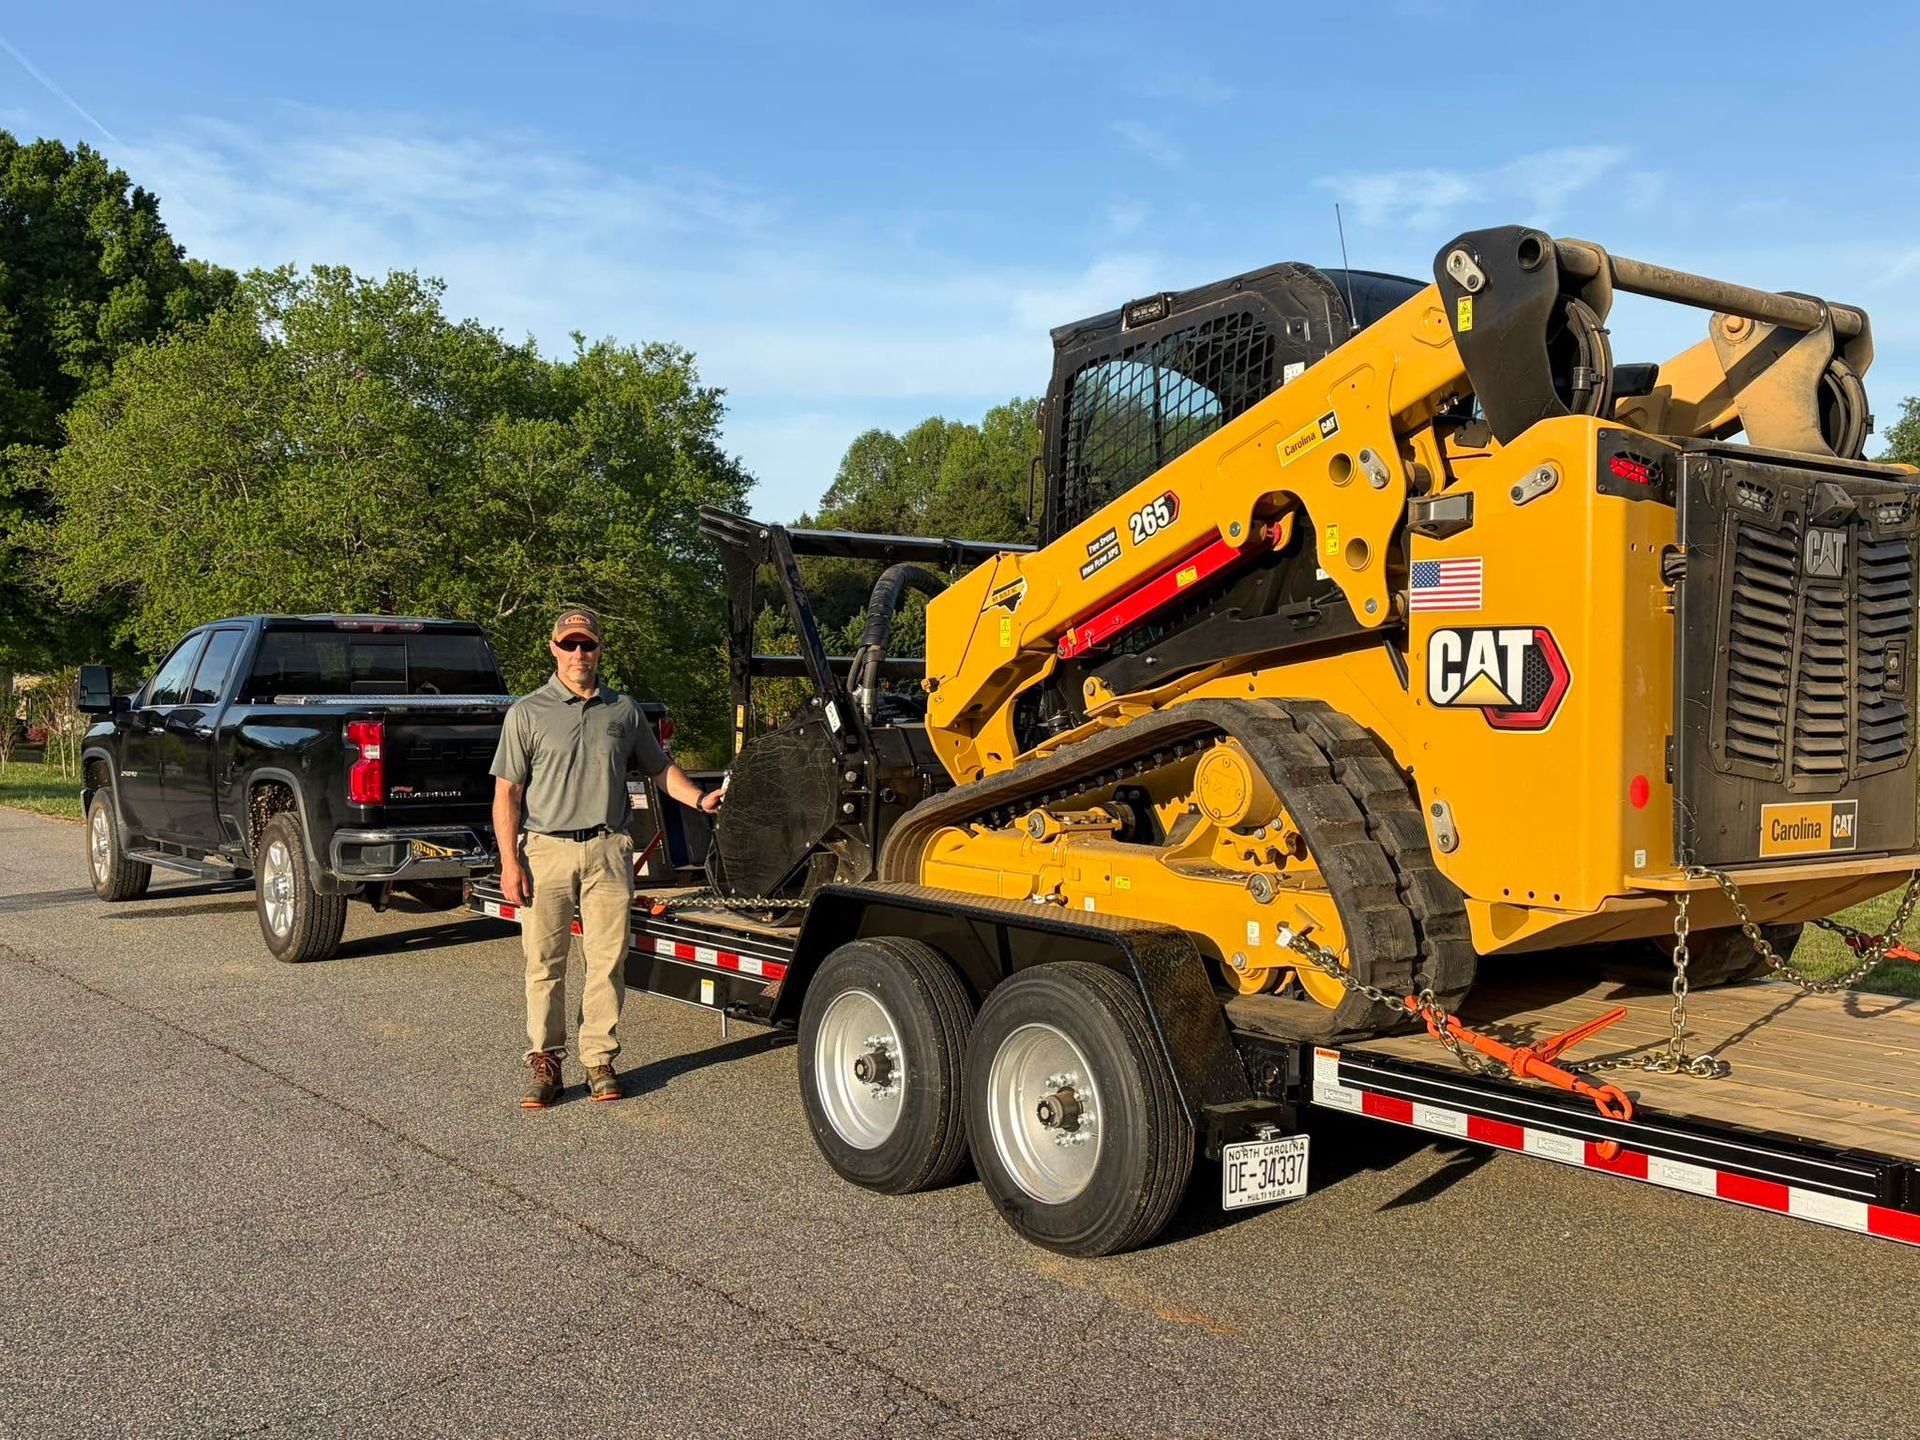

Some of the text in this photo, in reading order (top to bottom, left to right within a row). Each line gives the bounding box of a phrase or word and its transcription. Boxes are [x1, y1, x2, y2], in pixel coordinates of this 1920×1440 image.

[1284, 416, 1336, 456] Carolina CAT
[1129, 495, 1170, 545] 265
[1806, 529, 1847, 577] CAT
[1429, 629, 1534, 706] CAT
[1771, 814, 1854, 842] Carolina CAT
[1228, 1141, 1305, 1161] NORTH CAROLINA
[1228, 1153, 1305, 1194] DE-34337
